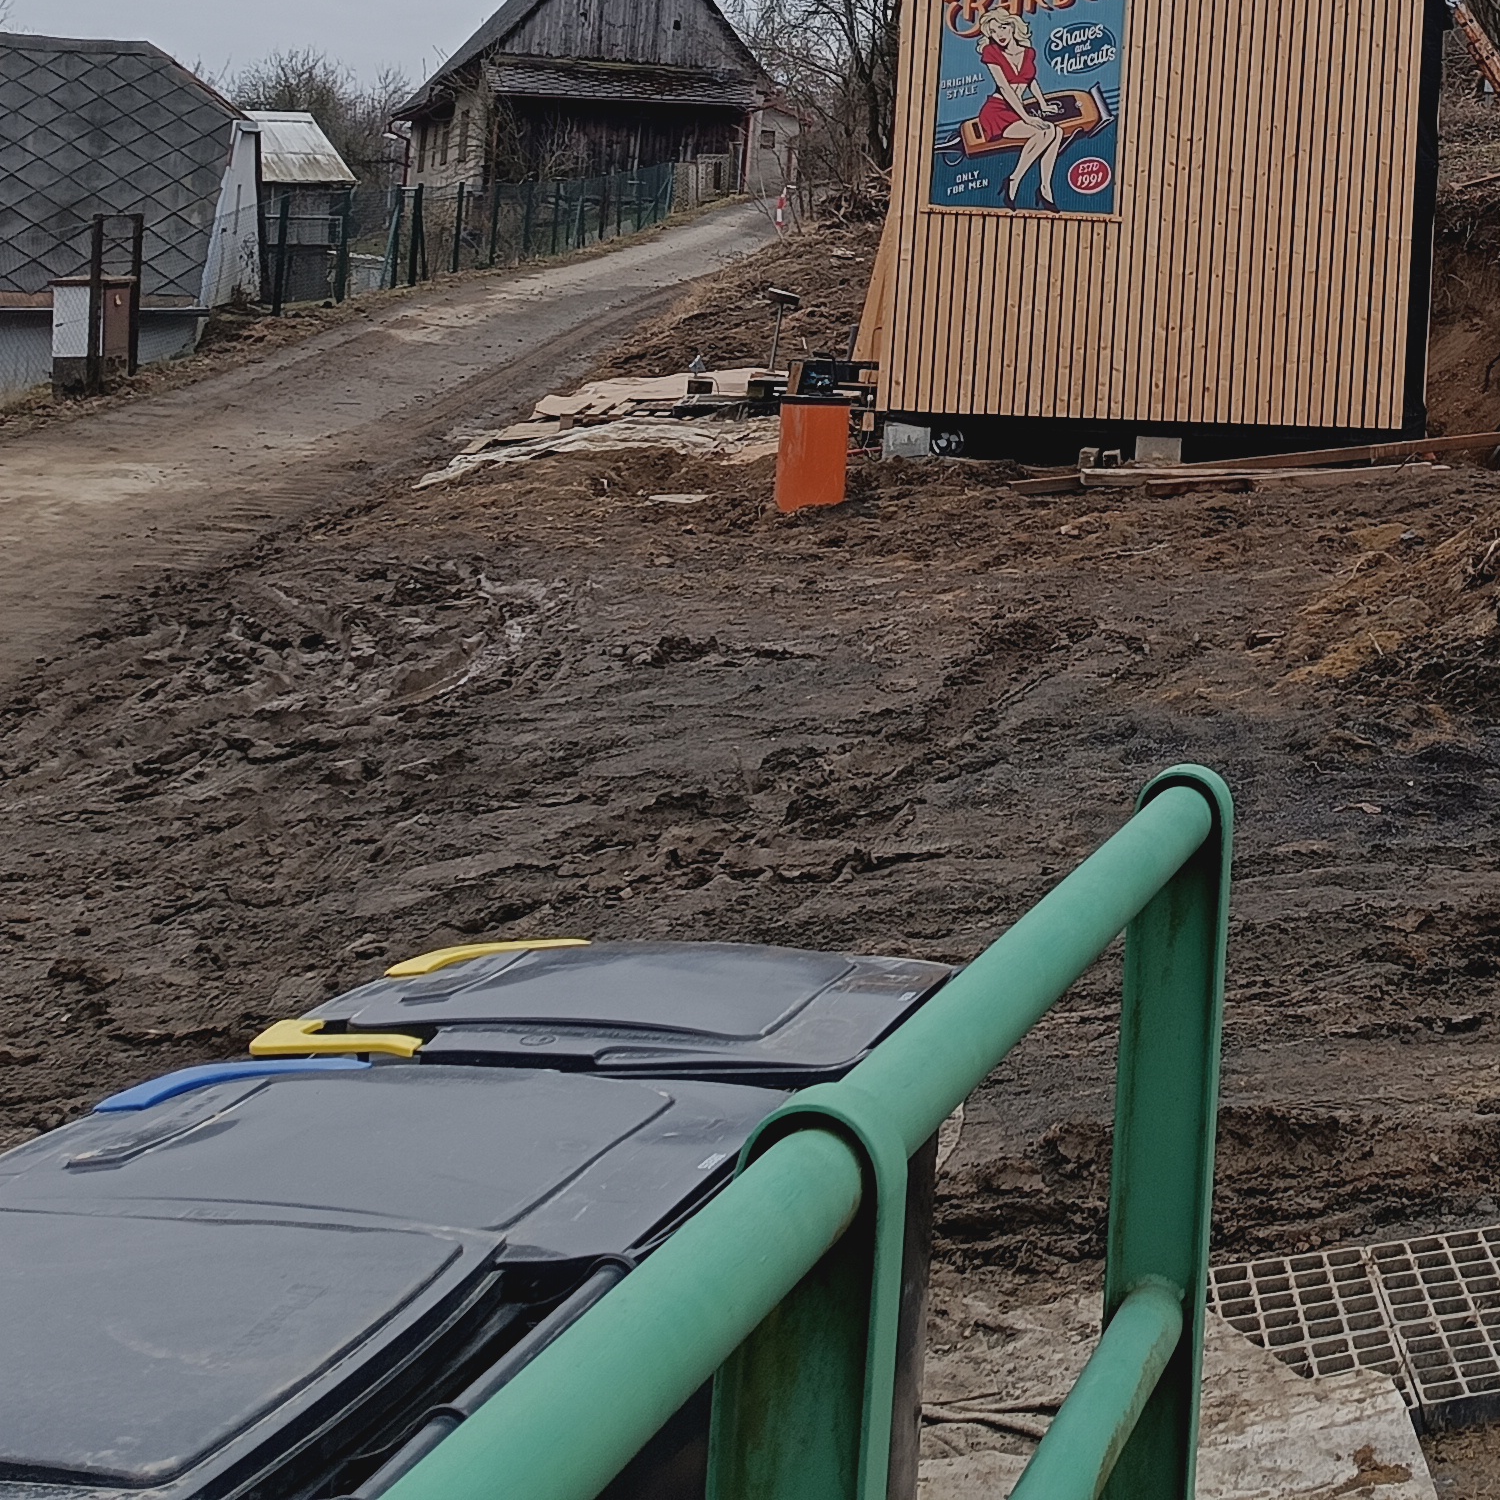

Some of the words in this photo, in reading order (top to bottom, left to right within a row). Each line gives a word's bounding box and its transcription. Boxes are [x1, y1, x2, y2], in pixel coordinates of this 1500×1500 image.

[1050, 24, 1104, 51] Shaves
[1074, 40, 1092, 54] and
[1051, 44, 1116, 76] Haircuts
[940, 73, 985, 90] ORIGINAL
[946, 85, 978, 100] STYLE
[956, 169, 980, 183] ONLY
[1078, 161, 1100, 174] ESTD
[947, 183, 965, 197] FOR
[968, 178, 989, 191] MEN
[1076, 171, 1103, 188] 1991
